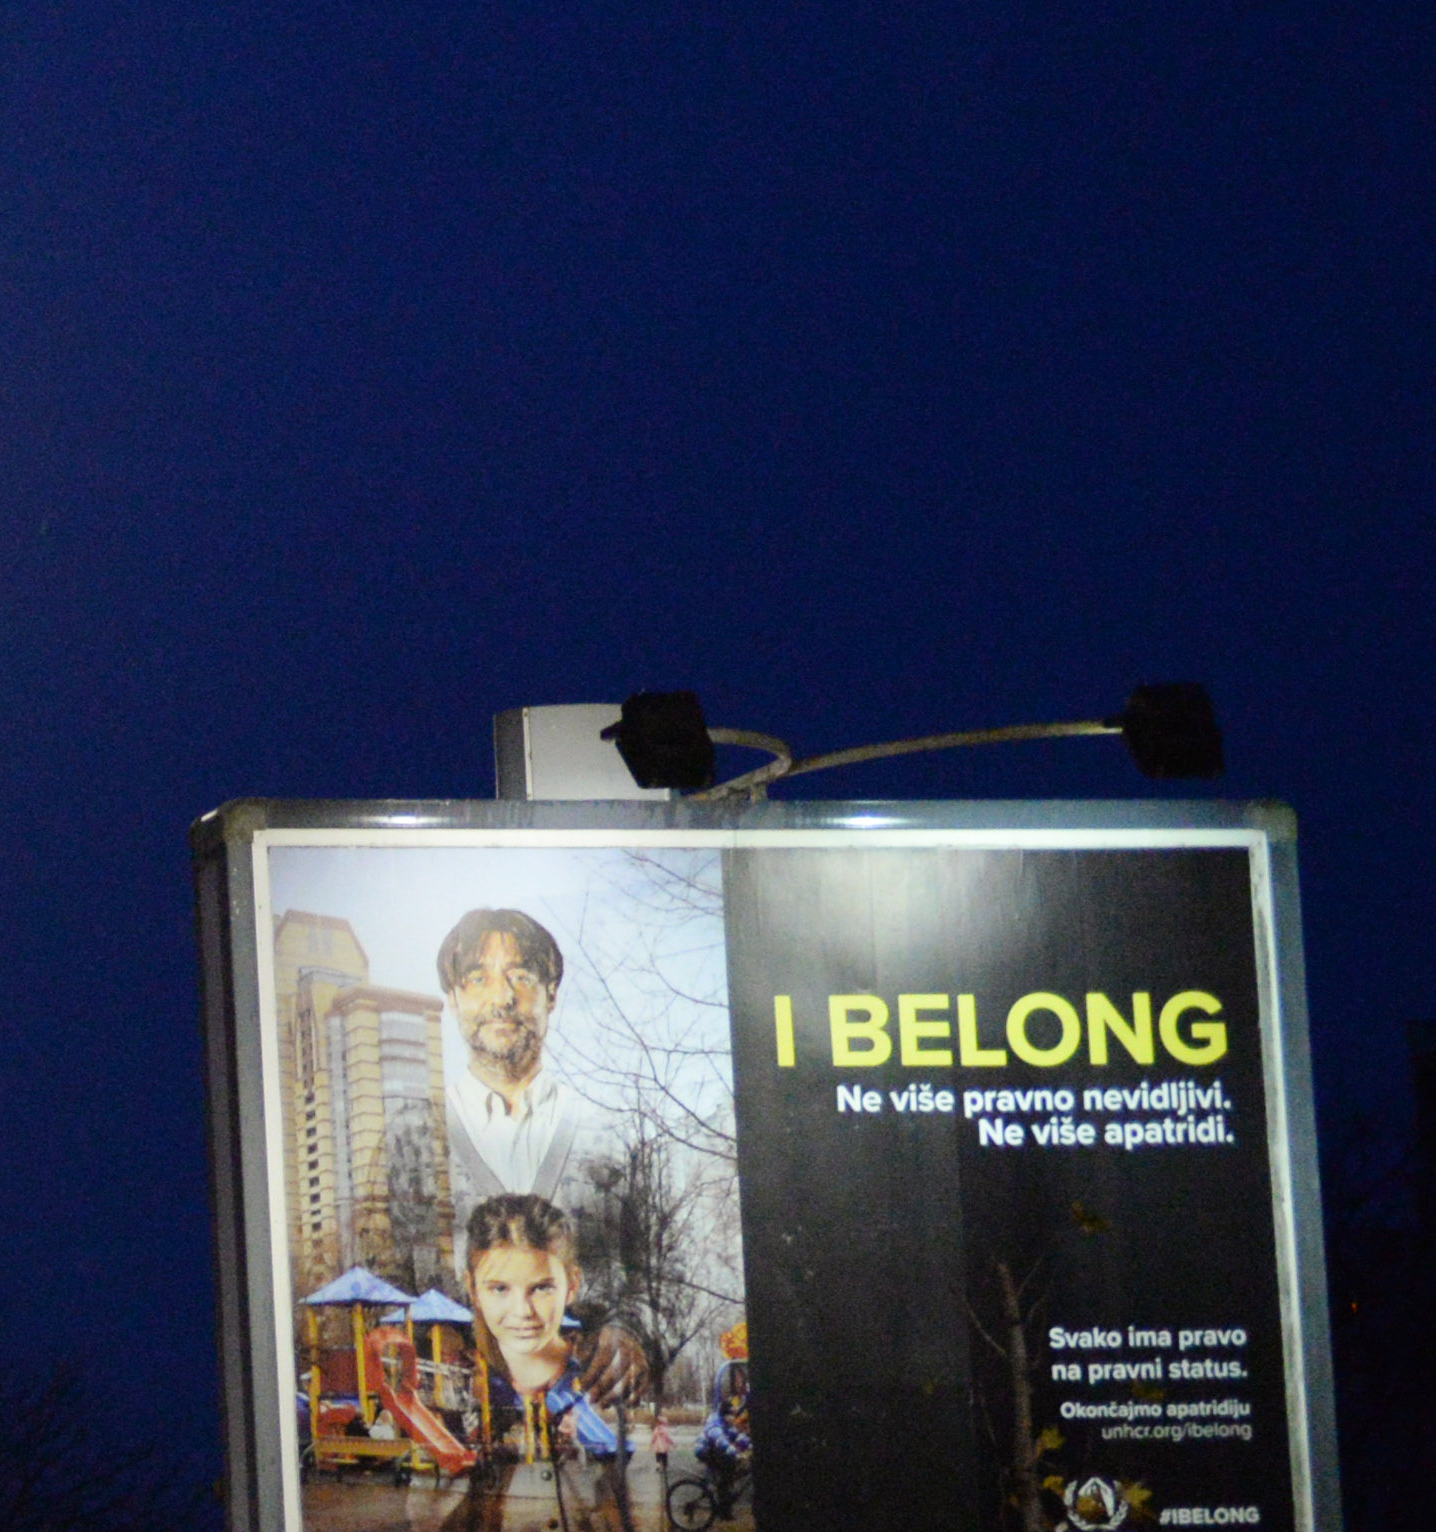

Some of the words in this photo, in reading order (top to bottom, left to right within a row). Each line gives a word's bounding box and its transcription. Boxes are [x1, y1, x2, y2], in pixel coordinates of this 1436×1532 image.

[773, 994, 797, 1068] I
[828, 990, 1227, 1068] BELONG
[837, 1084, 885, 1114] Ne
[889, 1080, 956, 1113] više
[963, 1088, 1076, 1120] pravno
[1082, 1080, 1232, 1117] nevidljivi.
[977, 1115, 1025, 1147] Ne
[1029, 1114, 1097, 1147] više
[1103, 1112, 1235, 1152] apatridi.
[1048, 1326, 1123, 1349] Svako
[1127, 1325, 1172, 1347] ima
[1178, 1328, 1248, 1351] pravo
[1051, 1363, 1082, 1381] na
[1087, 1357, 1163, 1385] pravni
[1168, 1358, 1249, 1379] status.
[1059, 1400, 1162, 1421] Okončajmo
[1166, 1398, 1251, 1420] apatridiju
[1101, 1422, 1253, 1441] unhcr.org/ibelong
[1159, 1506, 1261, 1526] #IBELONG
